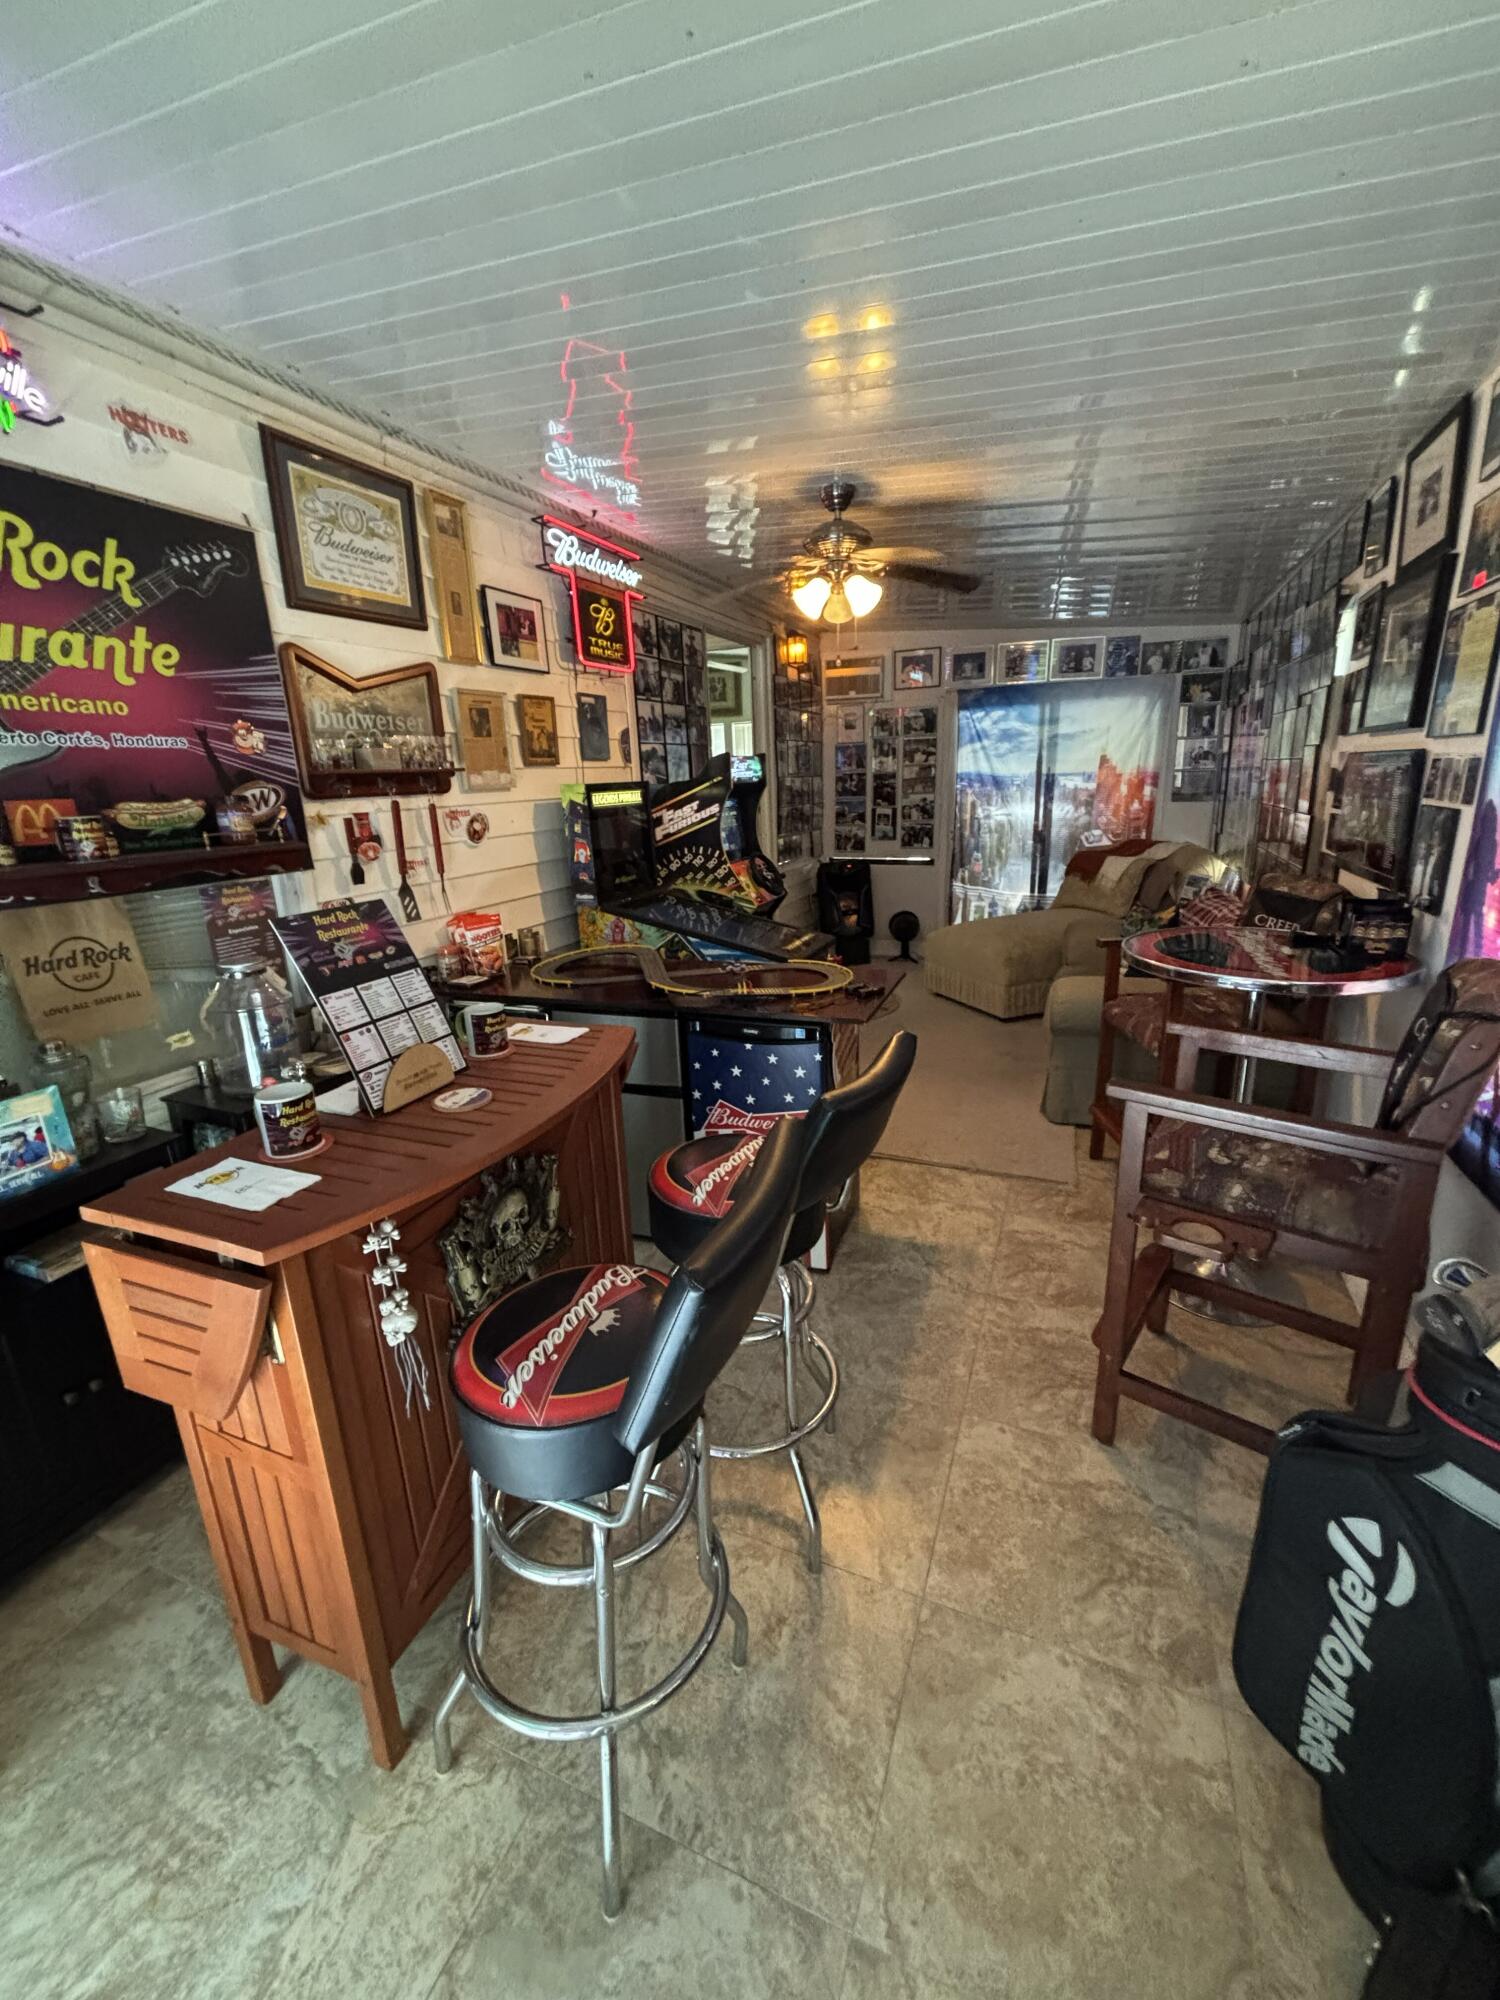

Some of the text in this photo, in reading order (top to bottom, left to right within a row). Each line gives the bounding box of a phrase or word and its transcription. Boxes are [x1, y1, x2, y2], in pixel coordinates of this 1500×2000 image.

[0, 510, 142, 607] Rock
[308, 520, 394, 564] Budweiser
[547, 527, 643, 588] Budweiser
[588, 635, 624, 651] TRUE
[590, 646, 626, 661] MUSIC
[309, 697, 425, 733] Budweiser
[41, 729, 109, 750] Cortés,
[111, 734, 188, 750] Honduras
[654, 803, 720, 842] FURIOUS
[312, 905, 360, 926] Hard Rock
[22, 941, 132, 977] Hard Rock
[282, 1101, 304, 1116] Hard
[706, 1105, 779, 1134] Budwei
[692, 1134, 765, 1207] udweiser
[499, 1264, 648, 1409] Budweiser
[1297, 1516, 1417, 1775] TaylorMade
